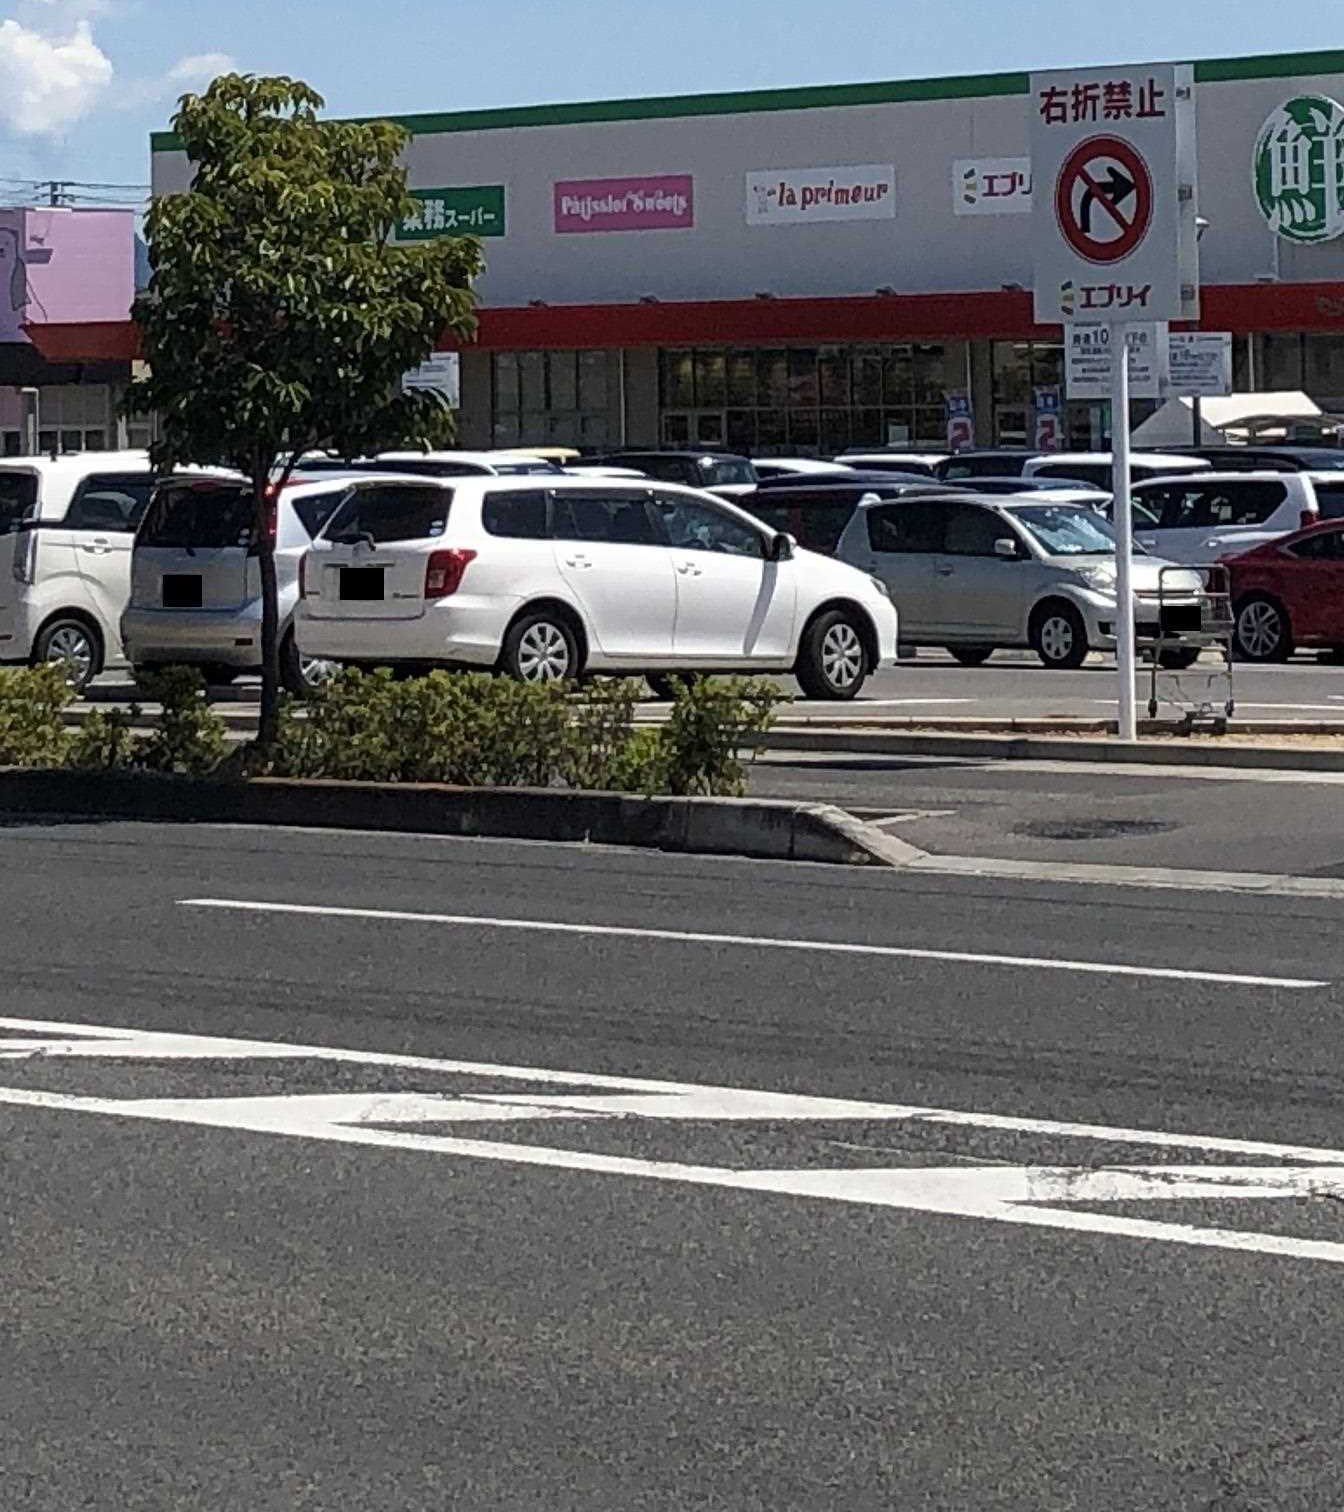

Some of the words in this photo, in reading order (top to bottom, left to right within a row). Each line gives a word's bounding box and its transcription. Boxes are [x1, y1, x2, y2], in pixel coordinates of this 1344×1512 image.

[1039, 78, 1166, 125] 右折禁止
[1079, 283, 1152, 309] エブリイ
